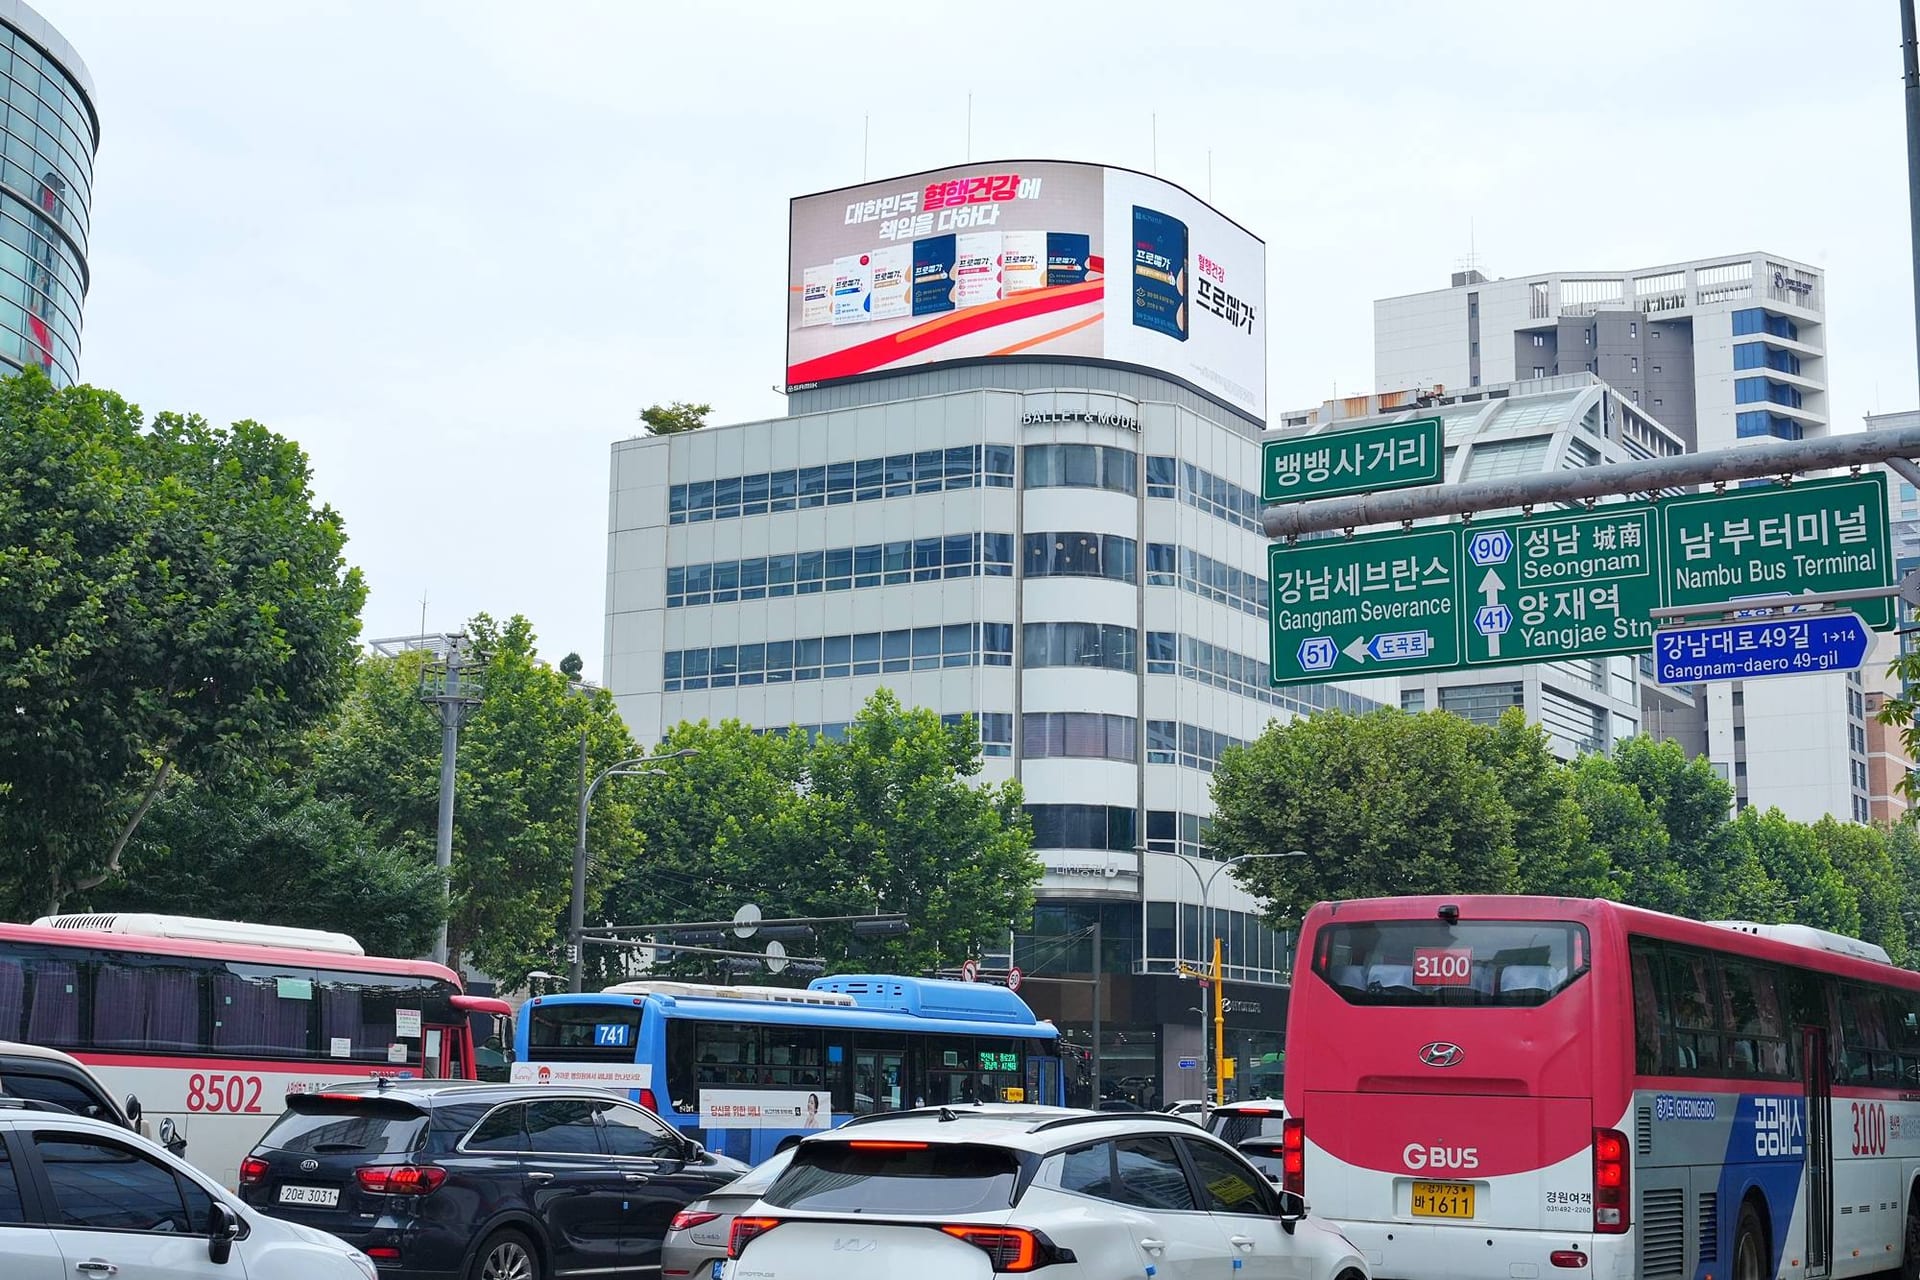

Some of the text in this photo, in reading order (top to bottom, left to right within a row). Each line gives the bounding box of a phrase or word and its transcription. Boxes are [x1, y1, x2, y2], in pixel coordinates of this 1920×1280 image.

[844, 174, 1042, 225] 대한민국 혈행건강에
[879, 204, 1000, 241] 책임을 다하다
[1136, 250, 1171, 270] 프로메가
[1198, 254, 1225, 283] 혈행건강
[1196, 277, 1255, 335] 프로메가
[1022, 410, 1081, 425] BALLET
[1083, 410, 1094, 423] &
[1275, 433, 1426, 487] 뱅뱅사거리
[1524, 522, 1641, 558] 성남 城南
[1679, 504, 1868, 561] 남부터미널
[1478, 537, 1504, 559] 90
[1278, 556, 1450, 604] 강남세브란스
[1524, 553, 1640, 579] Seongnam
[1676, 548, 1877, 590] Nambu Bus Terminal
[1279, 597, 1451, 632] Gangnam Severance
[1518, 584, 1620, 625] 양재역
[1482, 611, 1503, 629] 41
[1520, 617, 1652, 649] Yangjae Stn
[1307, 643, 1328, 664] 51
[1382, 636, 1424, 654] 도곡로
[1663, 623, 1810, 661] 강남대로49길
[1663, 650, 1838, 679] Gangnam-daero 49-gil
[1010, 974, 1019, 986] 50
[1415, 956, 1470, 977] 3100
[600, 1026, 624, 1044] 741
[186, 1073, 262, 1112] 8502
[711, 1105, 731, 1117] 당신을
[733, 1105, 746, 1117] 위한
[1657, 1098, 1715, 1118] 경기도 GYEONGGIDO
[1755, 1098, 1802, 1156] 공공버스
[1852, 1102, 1886, 1155] 3100
[308, 1189, 333, 1203] 3031
[1427, 1184, 1459, 1195] 경기 73
[1546, 1191, 1592, 1204] 경원여객
[1414, 1195, 1469, 1214] 바 1611
